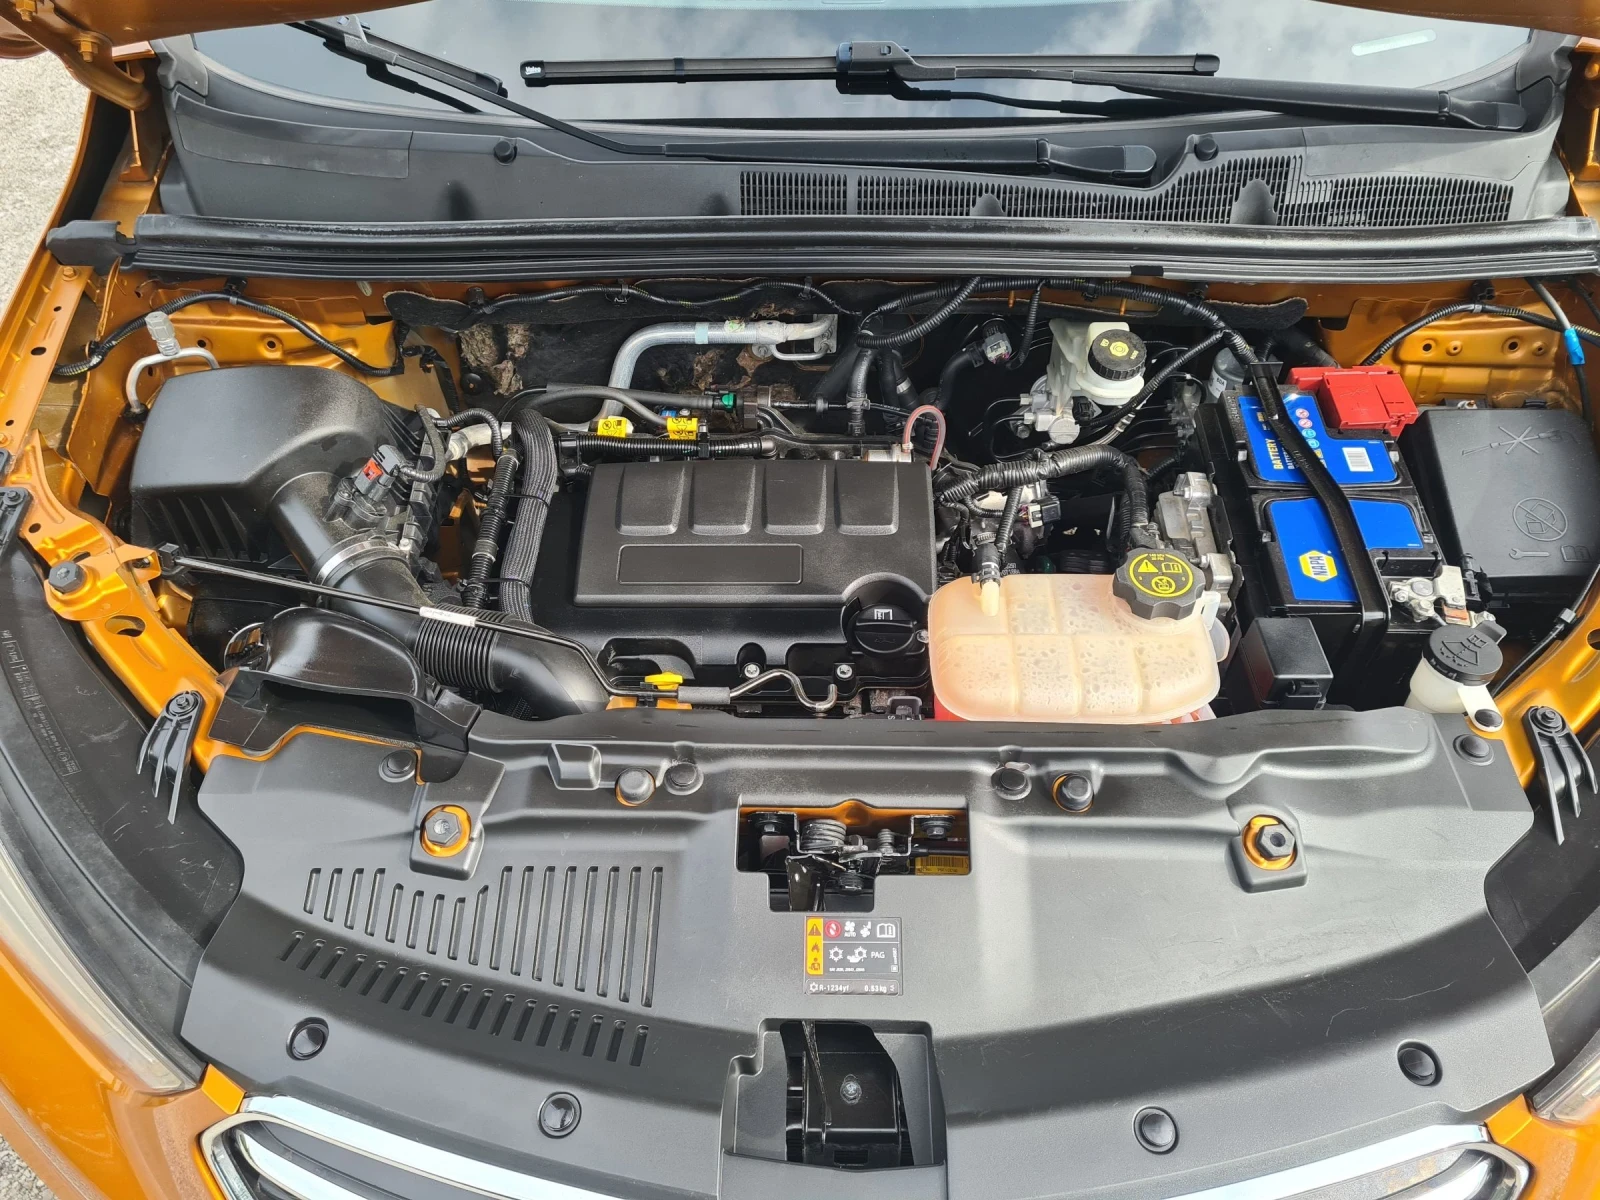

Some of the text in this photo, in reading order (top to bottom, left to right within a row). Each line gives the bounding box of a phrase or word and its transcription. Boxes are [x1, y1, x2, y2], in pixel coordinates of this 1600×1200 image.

[1265, 438, 1284, 470] BATTERY
[1311, 555, 1328, 577] NAPA
[870, 951, 886, 959] PAG
[819, 984, 850, 993] R-1234yf
[880, 985, 888, 994] kg
